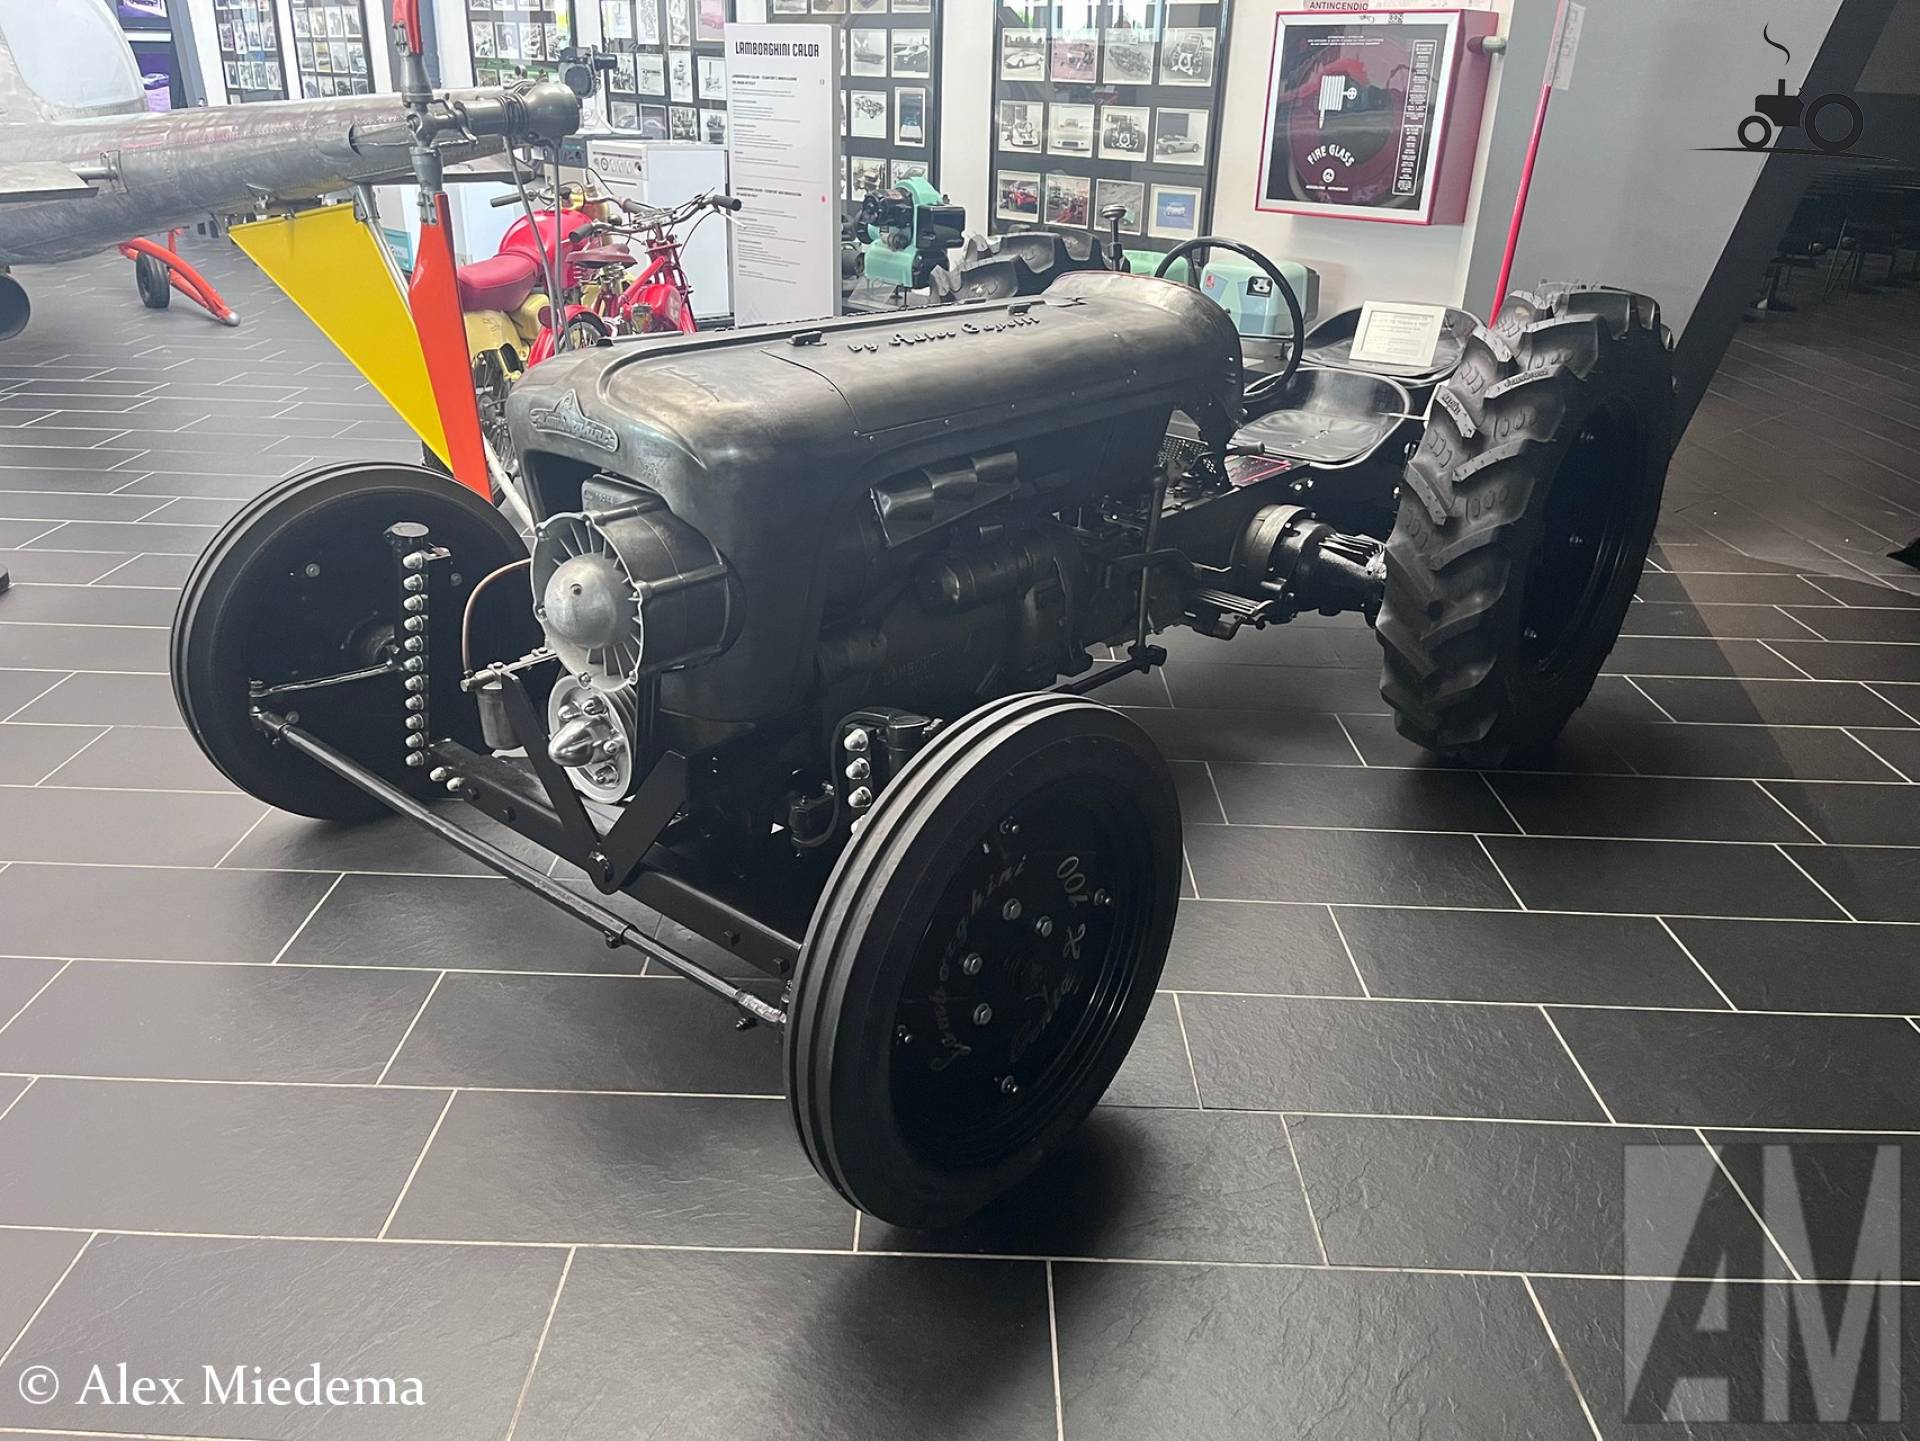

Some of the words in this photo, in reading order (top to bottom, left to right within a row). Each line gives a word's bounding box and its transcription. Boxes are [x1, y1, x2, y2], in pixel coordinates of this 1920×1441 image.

[1309, 1, 1368, 11] ANTINCENDIO
[735, 41, 790, 57] LAMBORGHINI
[792, 43, 819, 58] CALOR
[1307, 145, 1327, 165] FIRE
[1328, 144, 1355, 167] GLASS
